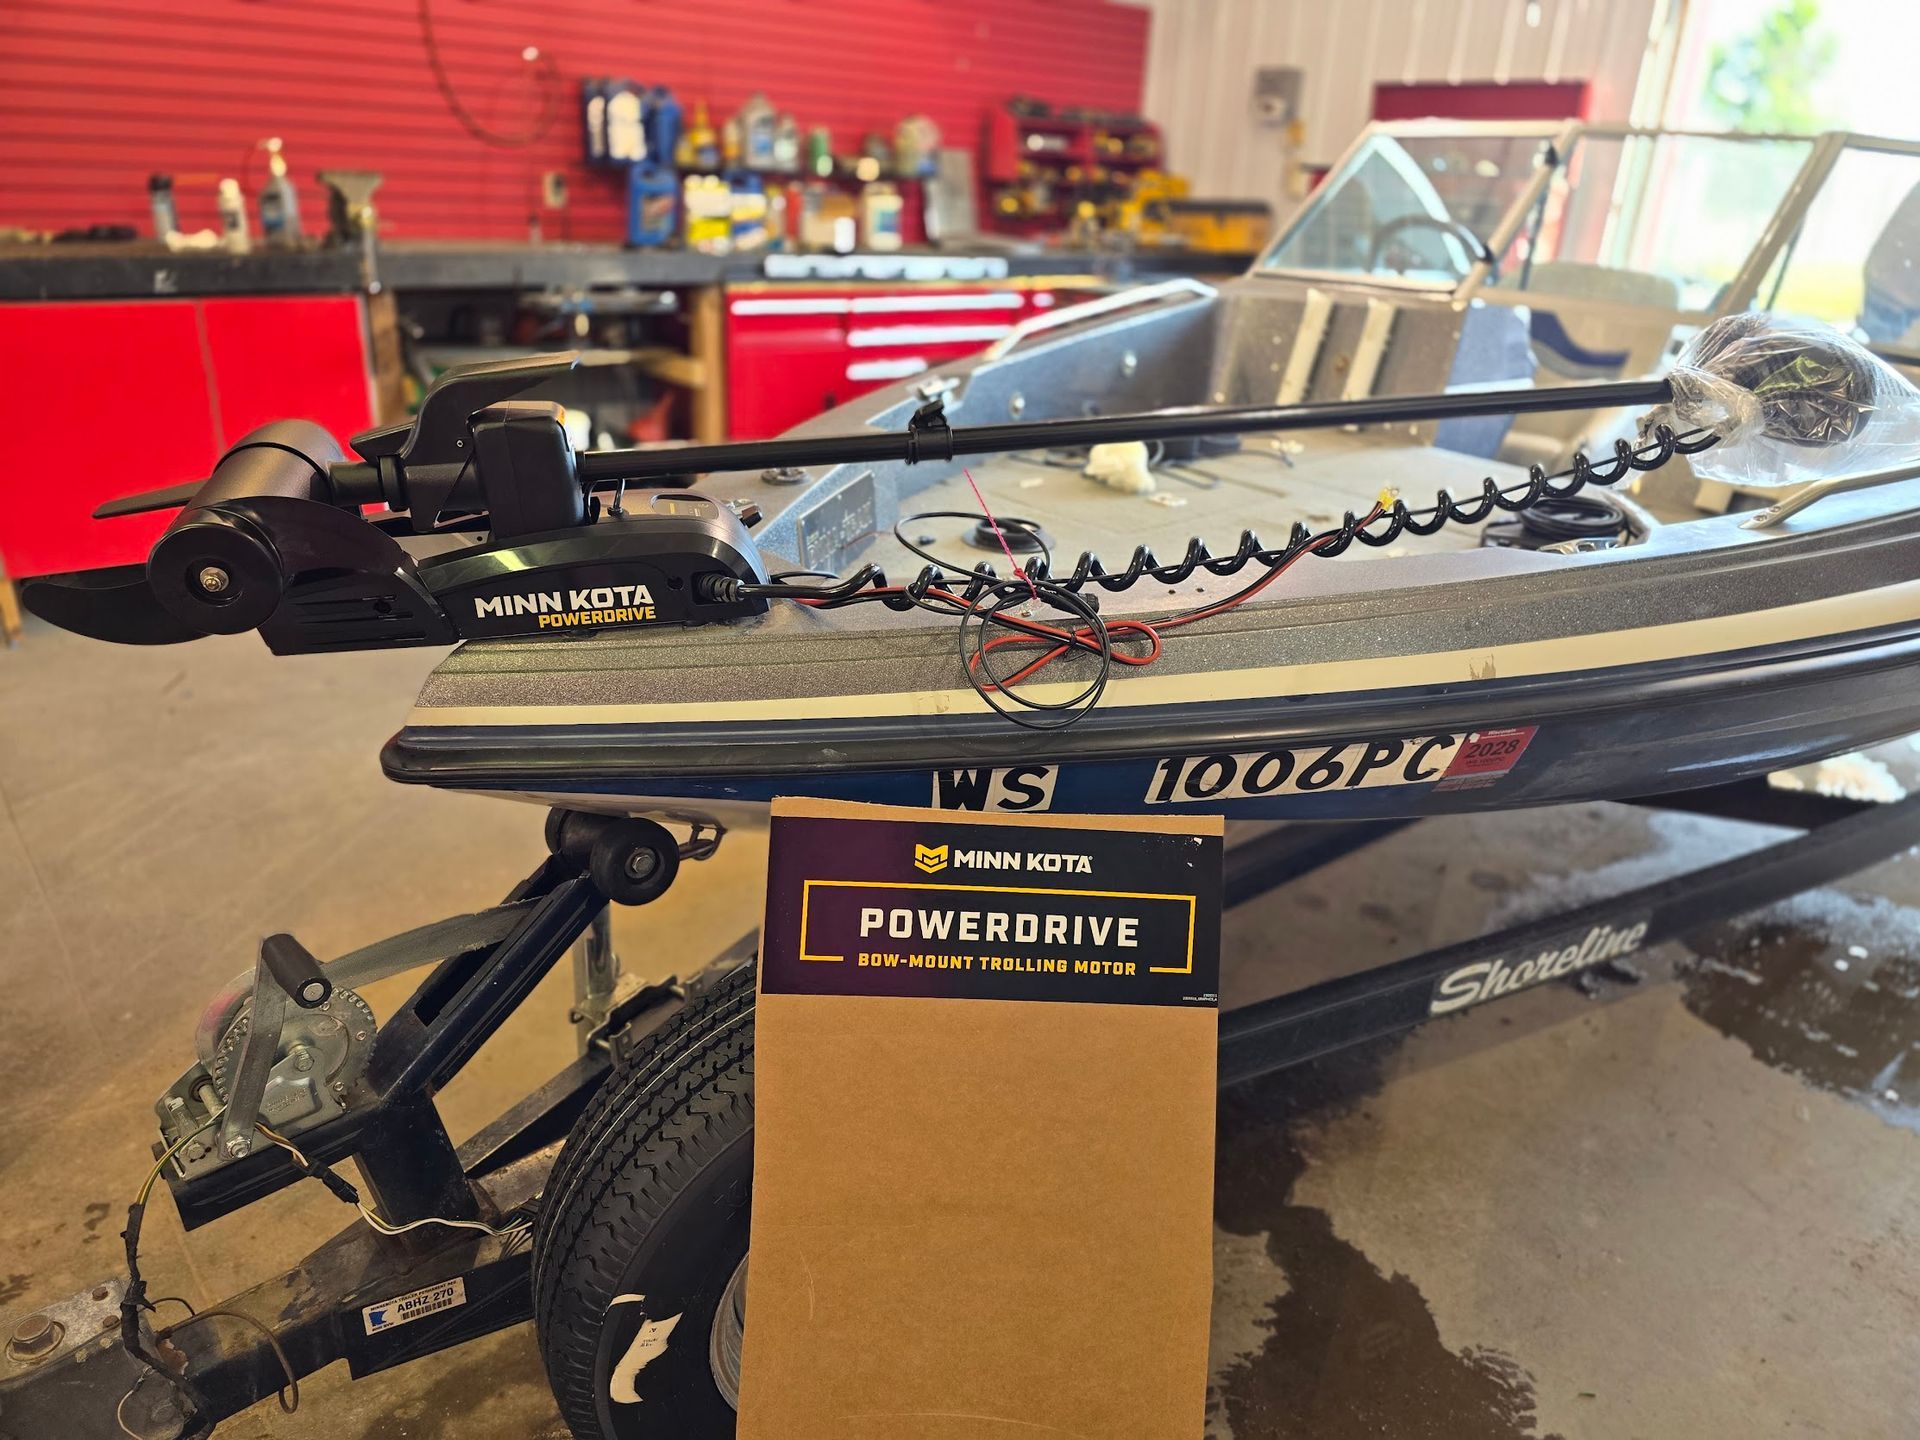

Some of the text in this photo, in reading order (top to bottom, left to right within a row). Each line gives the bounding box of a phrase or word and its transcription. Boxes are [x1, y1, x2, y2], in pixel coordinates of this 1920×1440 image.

[474, 584, 654, 618] MINN KOTA
[538, 606, 656, 628] POWERDRIVE
[1465, 740, 1520, 758] 2028
[939, 735, 1456, 811] WS 1006PC
[954, 849, 1021, 870] MINN
[860, 907, 1139, 948] POWERDRIVE
[858, 952, 1136, 976] BOW-MOUNT TROLLING MOTOR
[1430, 922, 1648, 1013] Shoreline
[397, 1287, 453, 1312] ABHZ 270
